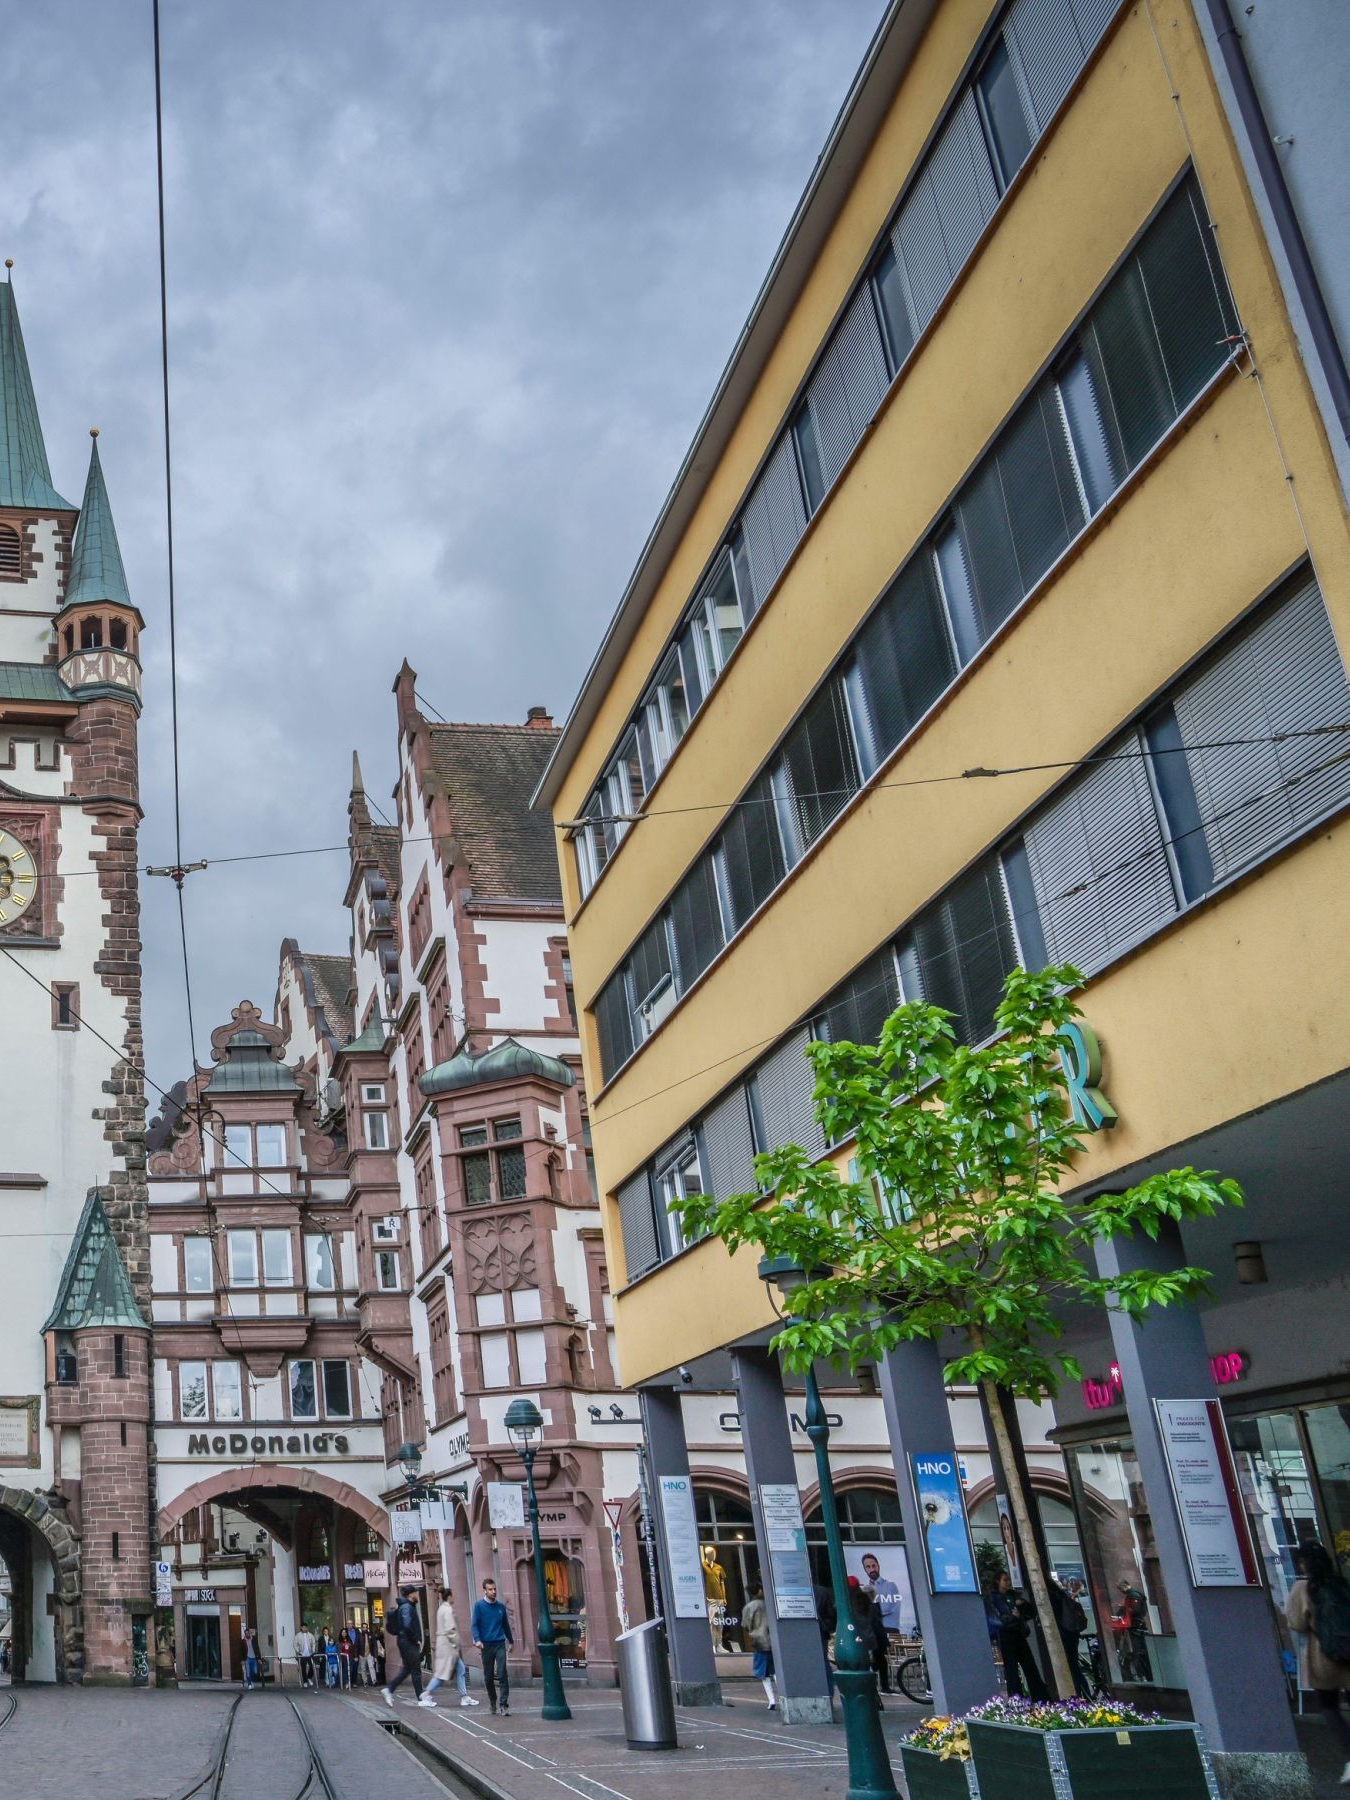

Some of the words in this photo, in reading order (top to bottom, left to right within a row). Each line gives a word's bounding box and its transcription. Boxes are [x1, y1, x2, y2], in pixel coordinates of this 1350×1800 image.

[916, 1462, 951, 1475] HNO
[663, 1481, 687, 1490] HNO
[524, 1512, 566, 1522] OYMP
[713, 1617, 738, 1626] SHOP
